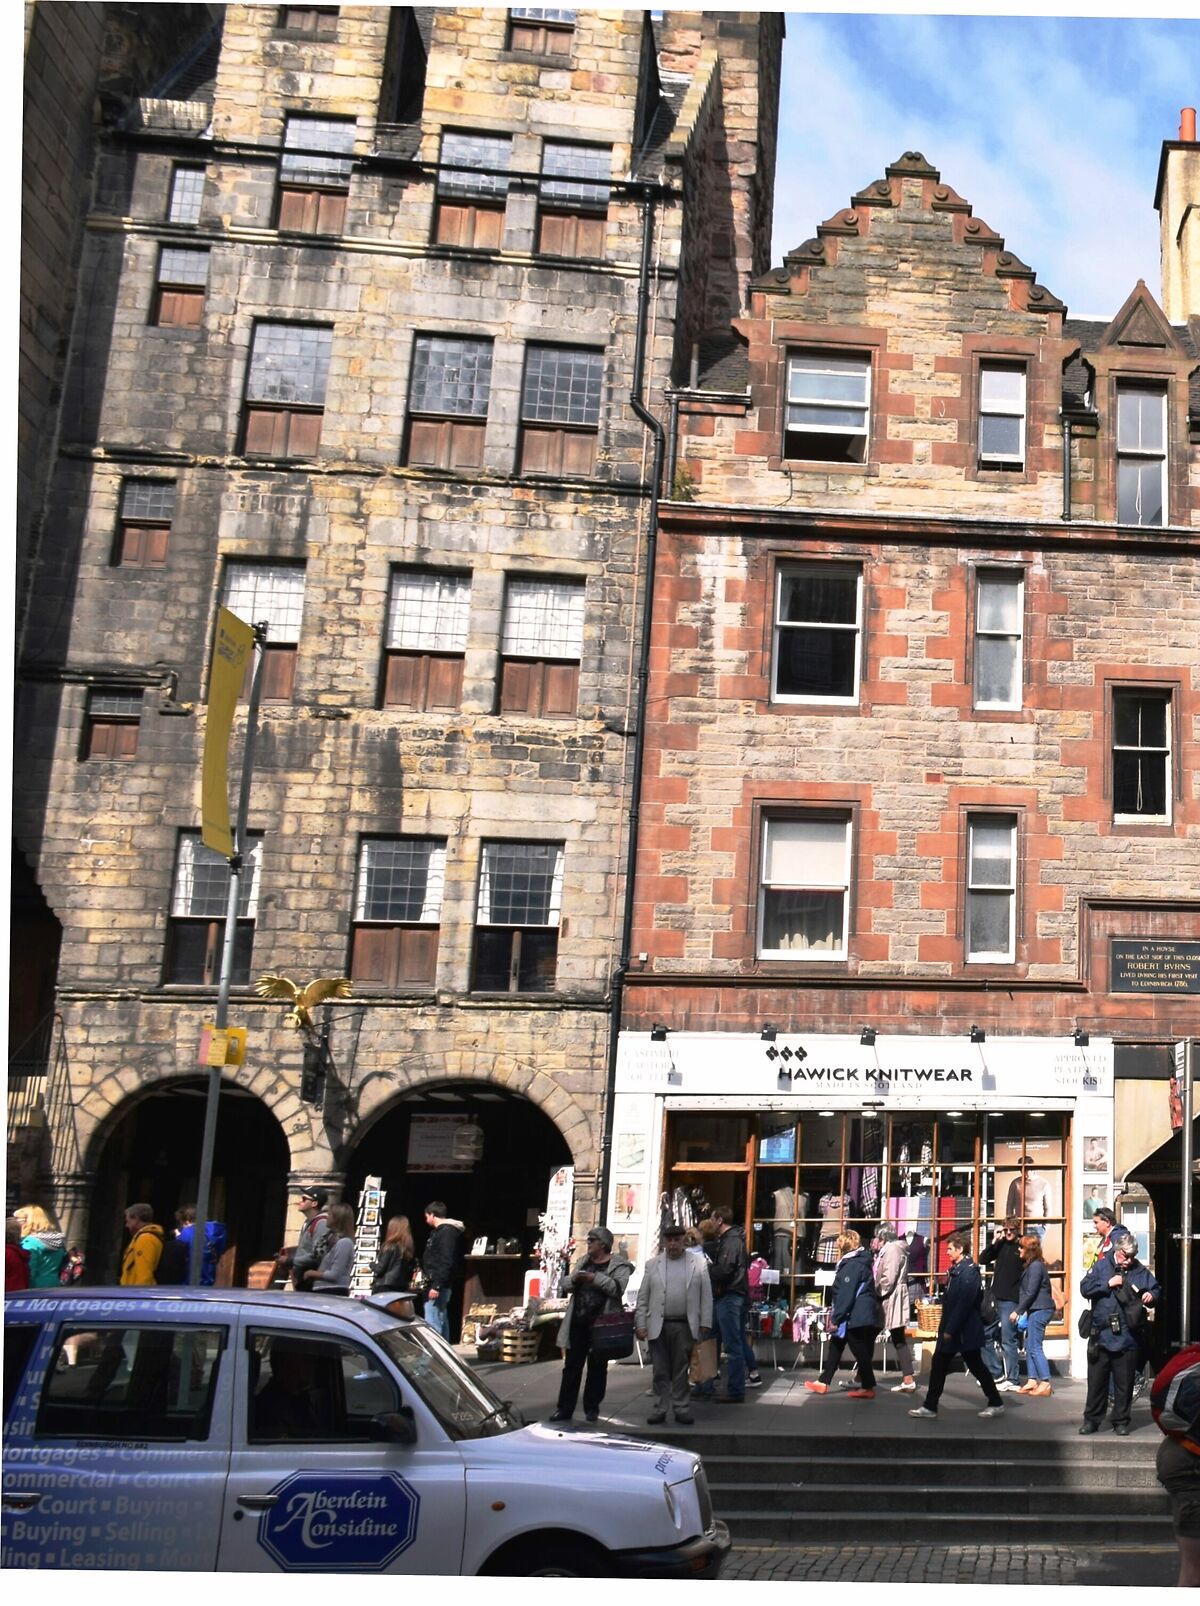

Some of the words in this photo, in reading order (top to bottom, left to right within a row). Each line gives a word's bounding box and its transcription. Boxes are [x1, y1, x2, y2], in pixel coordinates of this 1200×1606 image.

[778, 1067, 860, 1081] HAWICK
[865, 1068, 973, 1081] KNITWEAR
[815, 1081, 846, 1089] MADE
[27, 1298, 136, 1316] Mortgages
[3, 1468, 114, 1488] ommercial
[133, 1469, 191, 1489] Court
[38, 1495, 97, 1515] Court
[115, 1495, 191, 1520] Buying
[274, 1489, 388, 1532] Aberdein
[12, 1520, 86, 1545] Buying
[105, 1520, 177, 1545] Selling
[302, 1509, 398, 1549] Considine
[60, 1548, 141, 1570] Leasing
